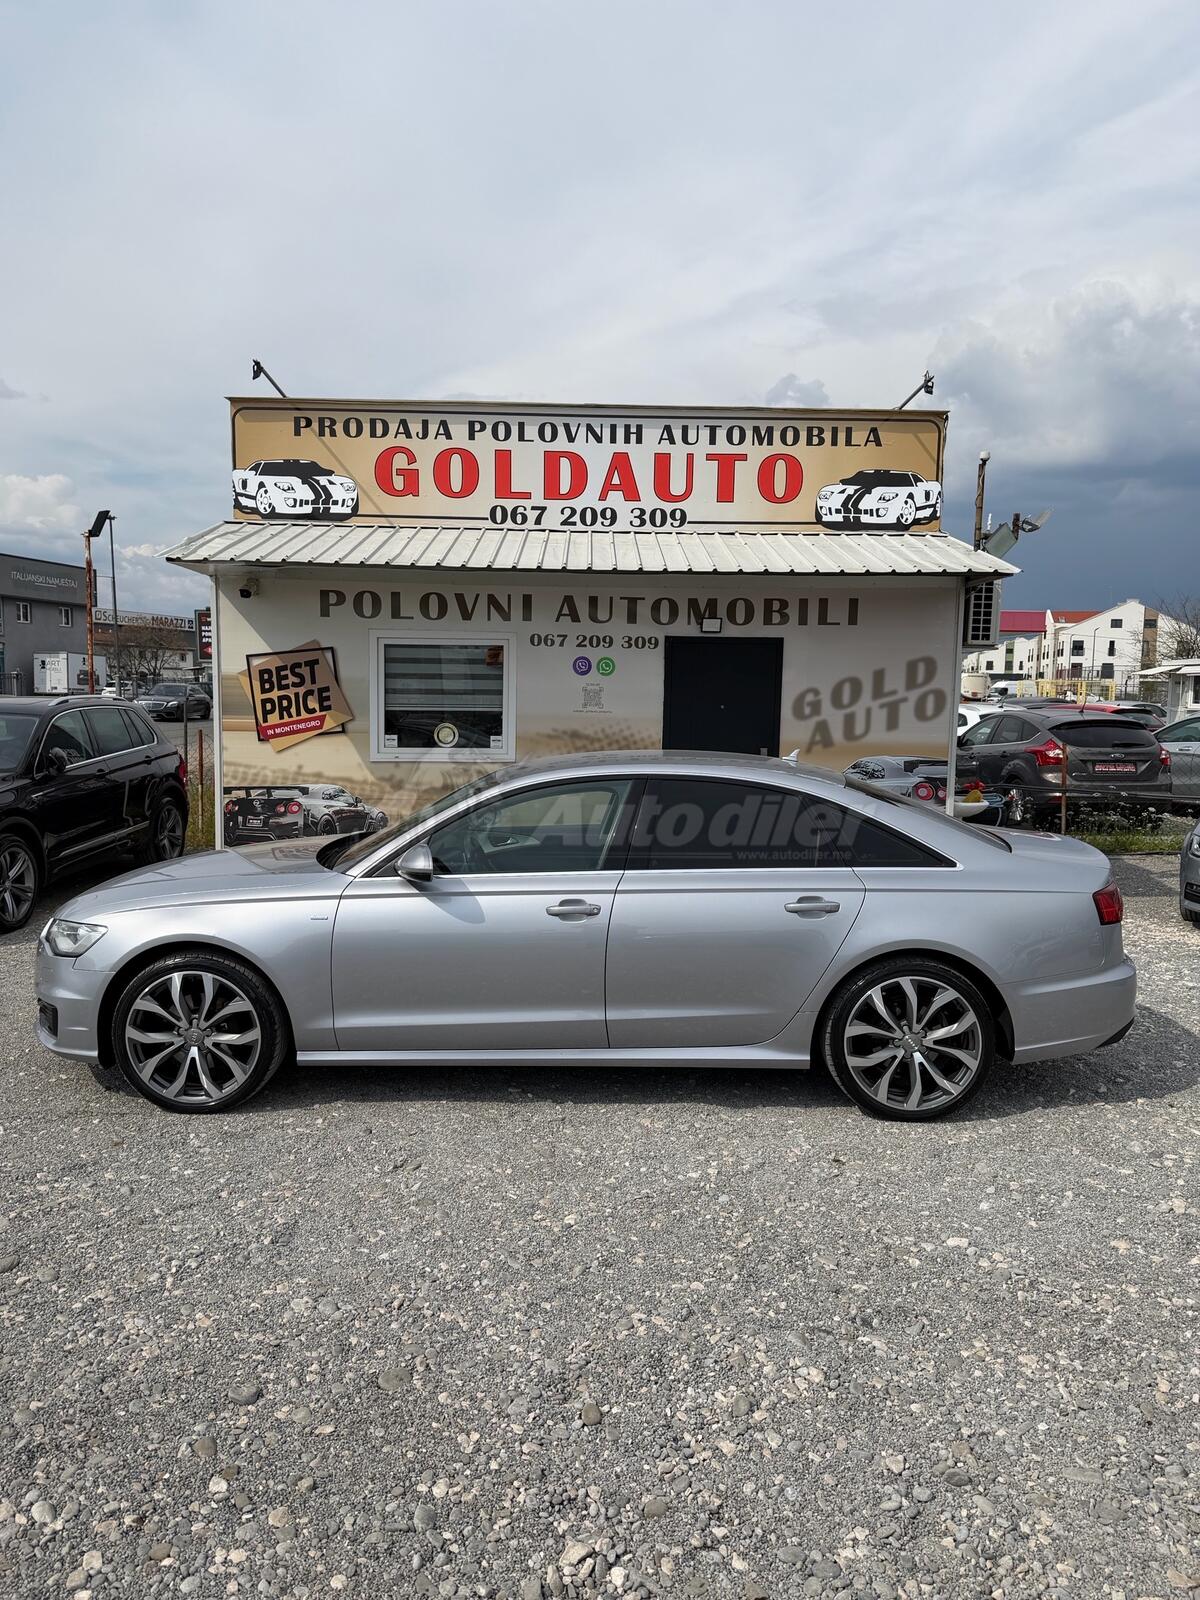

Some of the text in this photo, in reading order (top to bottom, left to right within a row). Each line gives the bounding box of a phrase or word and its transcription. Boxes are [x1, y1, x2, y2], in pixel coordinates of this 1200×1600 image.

[293, 415, 883, 448] PRODAJA POLOVNIH AUTOMOBILA
[374, 445, 804, 504] GOLDAUTO
[489, 504, 688, 528] 067 209 309
[151, 615, 187, 629] MARAZZI
[319, 589, 860, 627] POLOVNI AUTOMOBILI
[529, 633, 660, 650] 067 209 309
[258, 658, 320, 695] BEST
[791, 656, 938, 722] GOLD
[260, 685, 332, 724] PRICE
[805, 687, 948, 755] AUTO
[267, 719, 321, 736] IN MONTENEGRO
